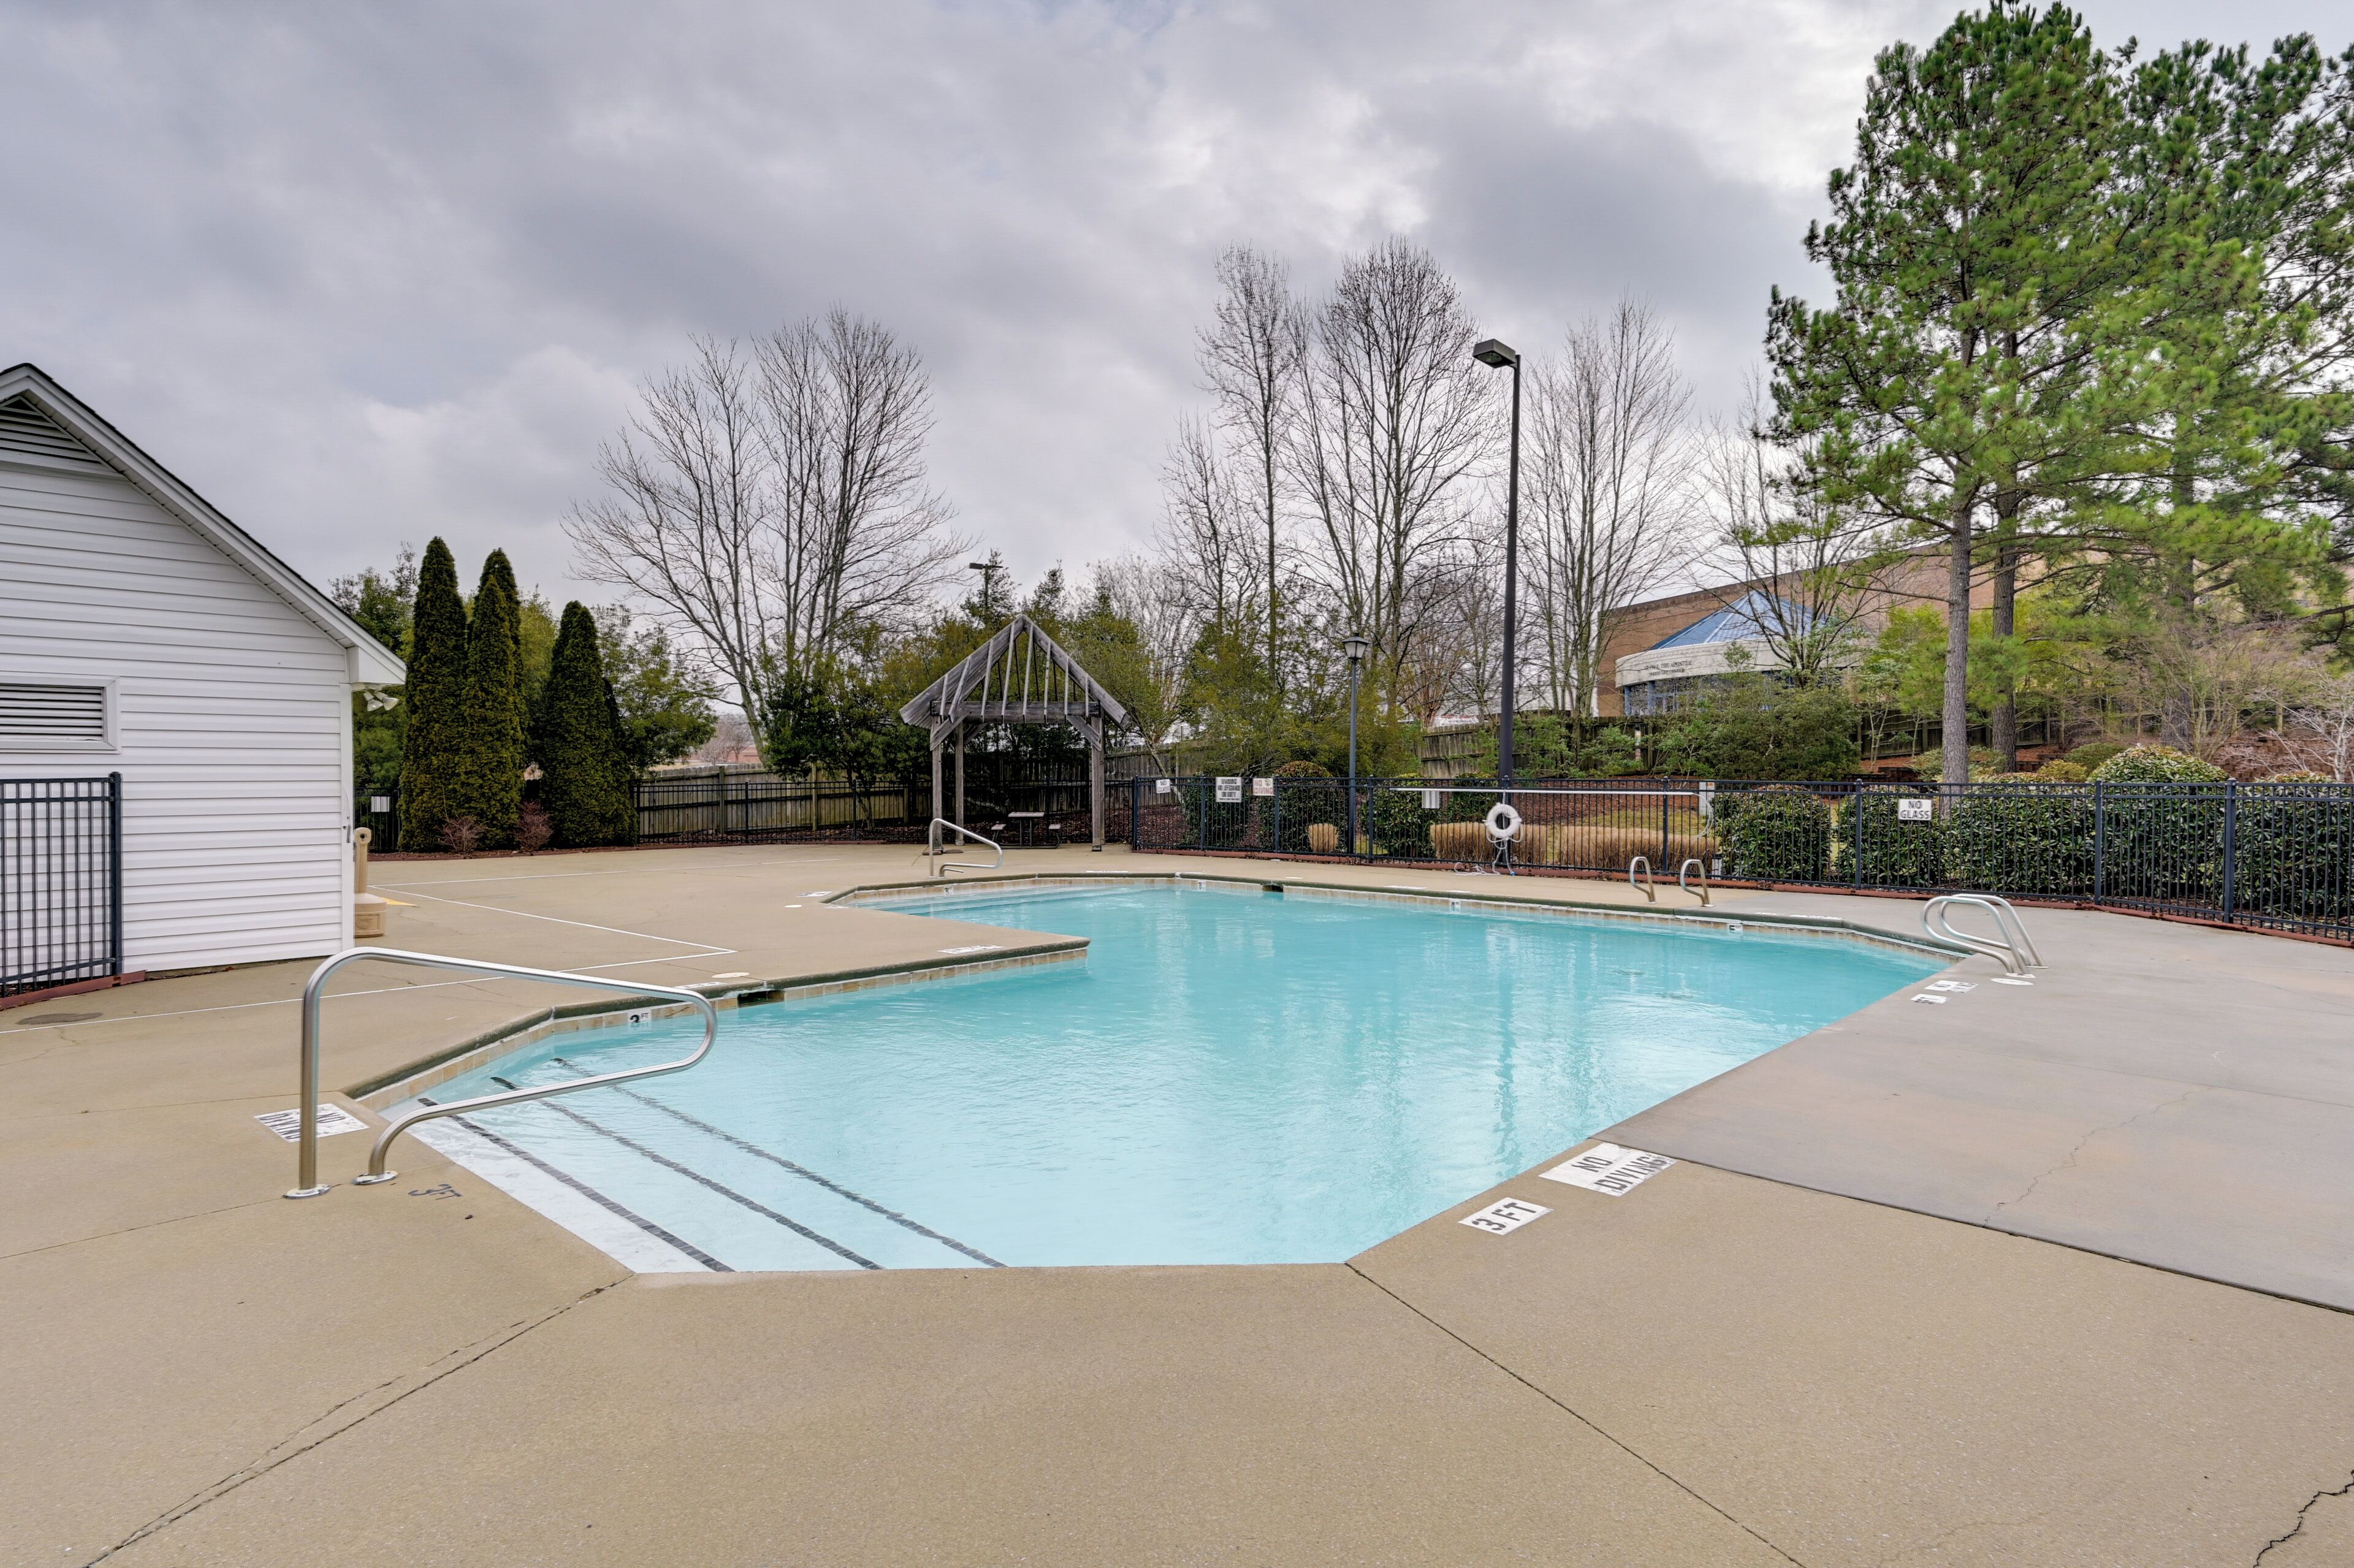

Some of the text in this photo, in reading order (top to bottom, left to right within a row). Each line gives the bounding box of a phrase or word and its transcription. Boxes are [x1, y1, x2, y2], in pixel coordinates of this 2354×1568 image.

[1908, 800, 1923, 809] NO
[1900, 810, 1930, 819] GLASS
[1571, 1156, 1613, 1173] NO
[1593, 1155, 1667, 1192] DIVING
